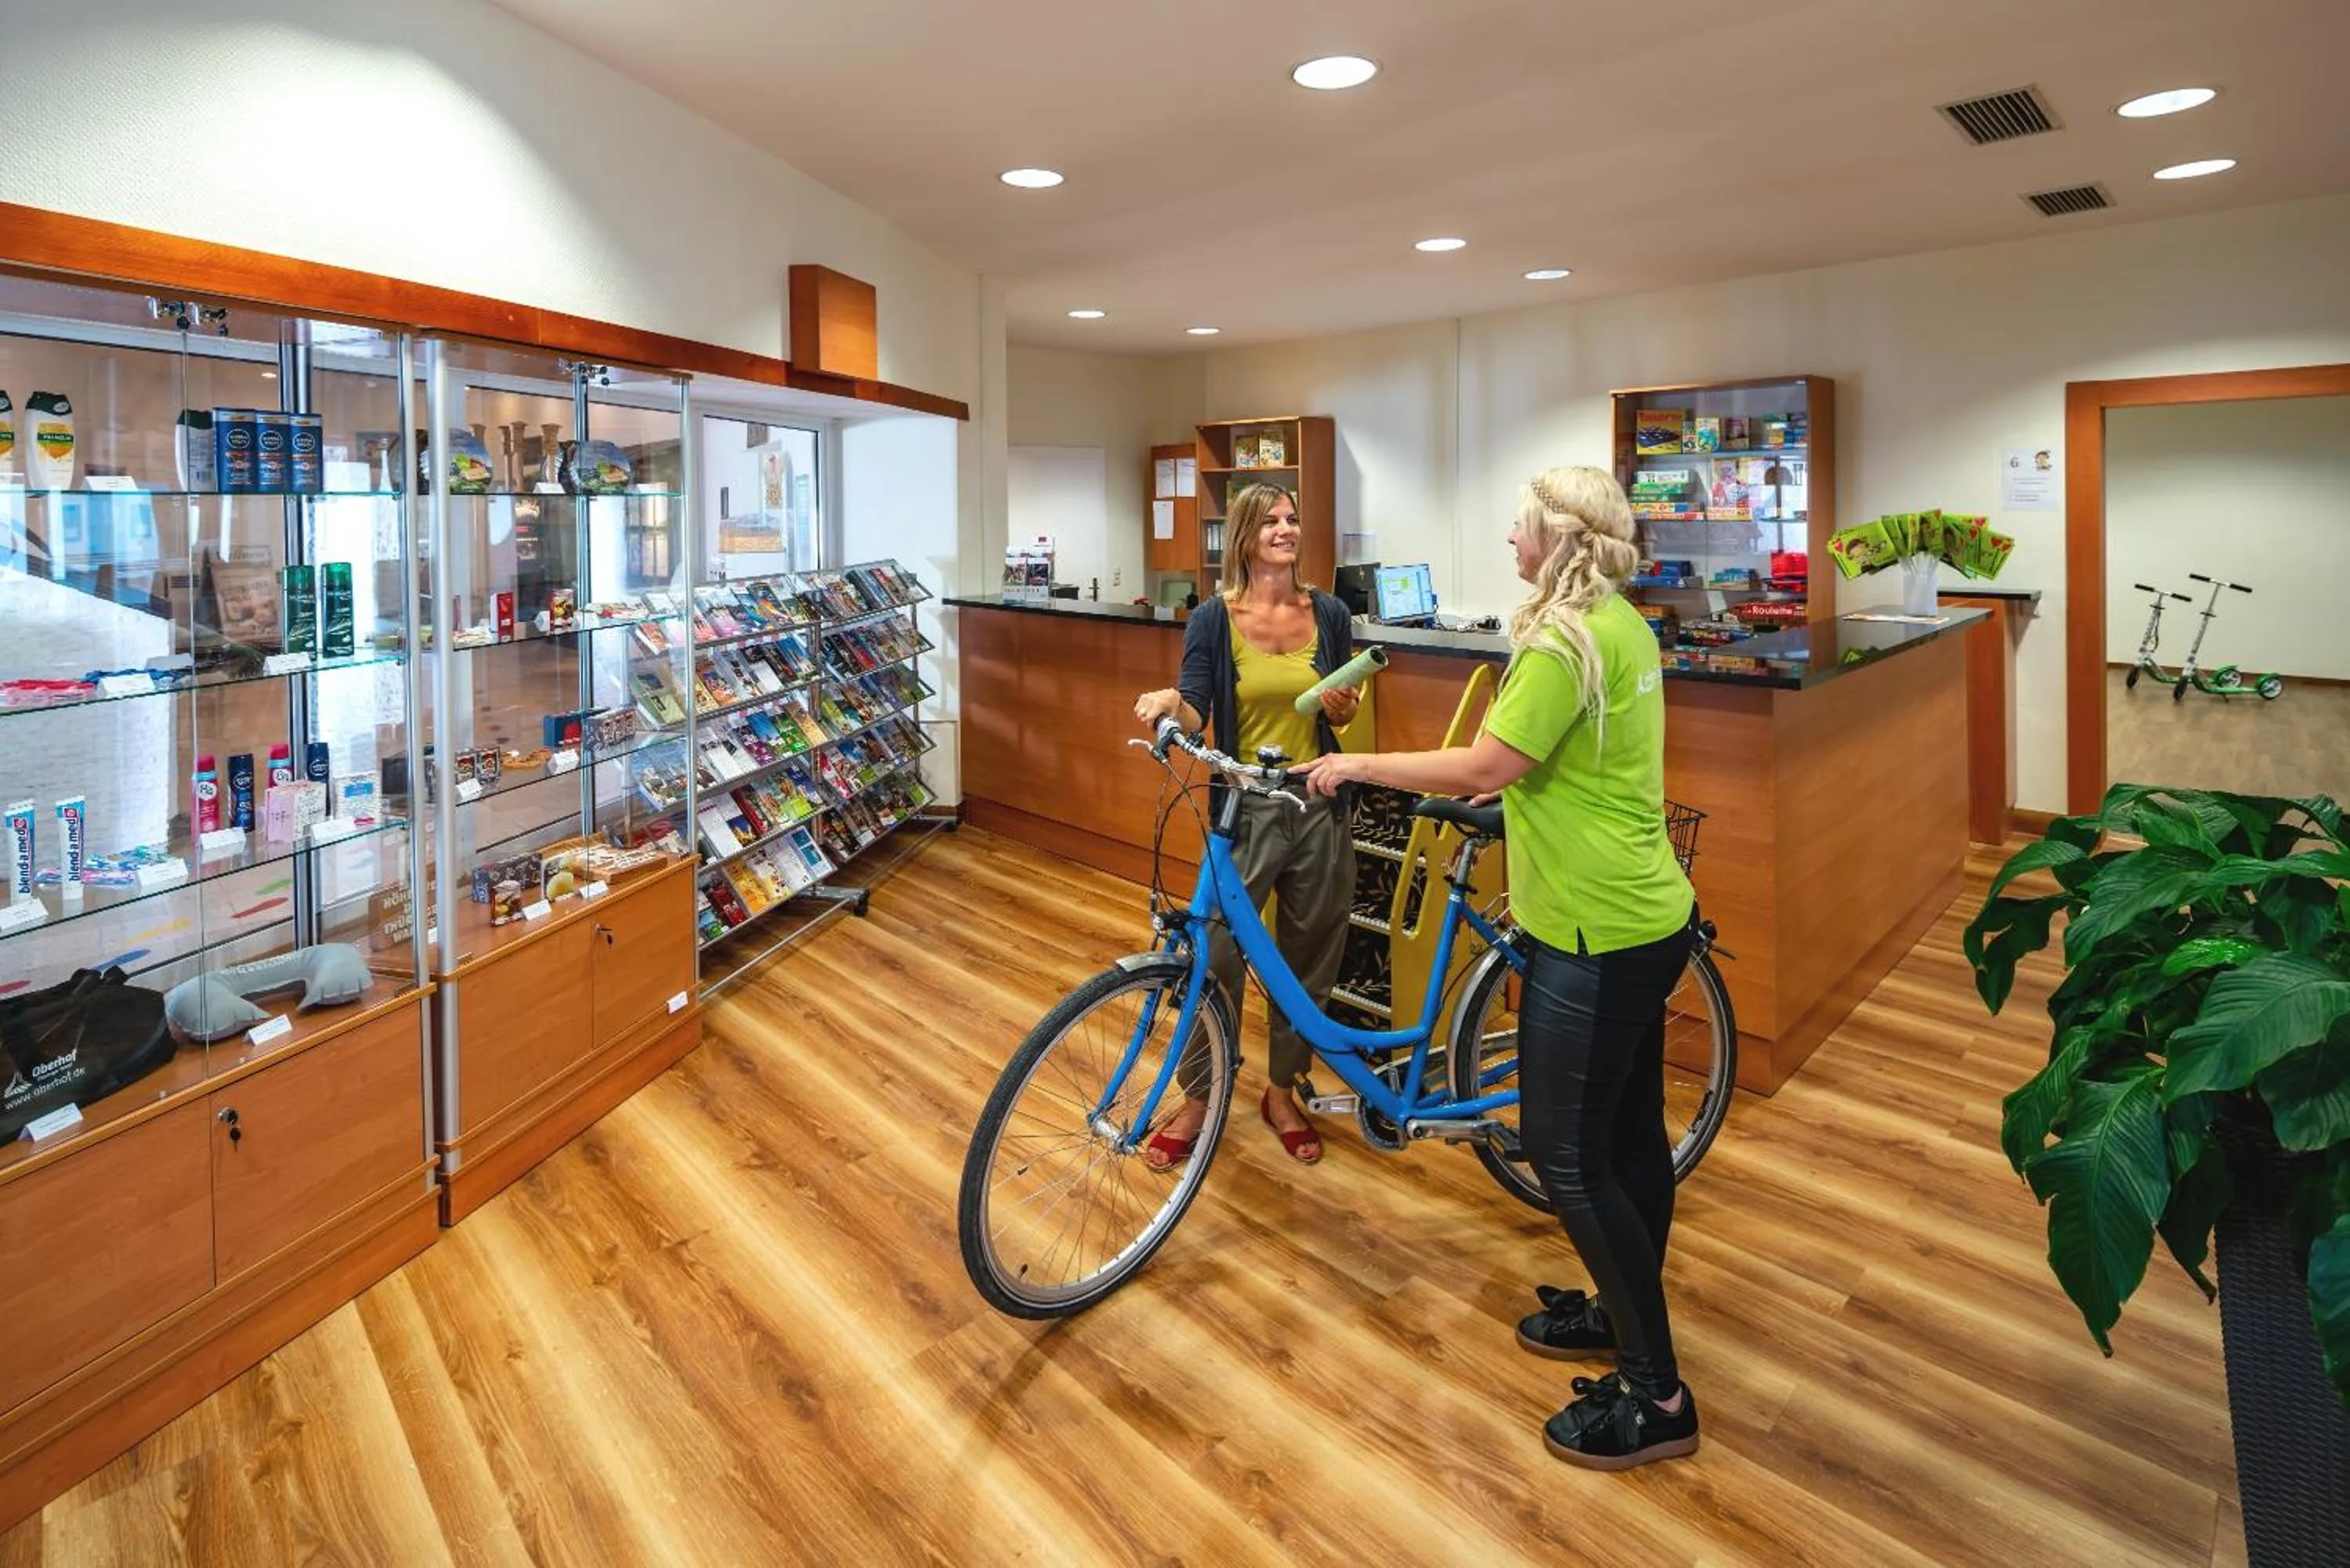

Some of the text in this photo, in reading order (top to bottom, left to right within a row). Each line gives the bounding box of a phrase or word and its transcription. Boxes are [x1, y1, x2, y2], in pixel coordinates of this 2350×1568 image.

[1752, 605, 1793, 616] Roulette
[32, 1048, 77, 1078] Oberhof
[5, 1067, 85, 1110] www.oberhof.de
